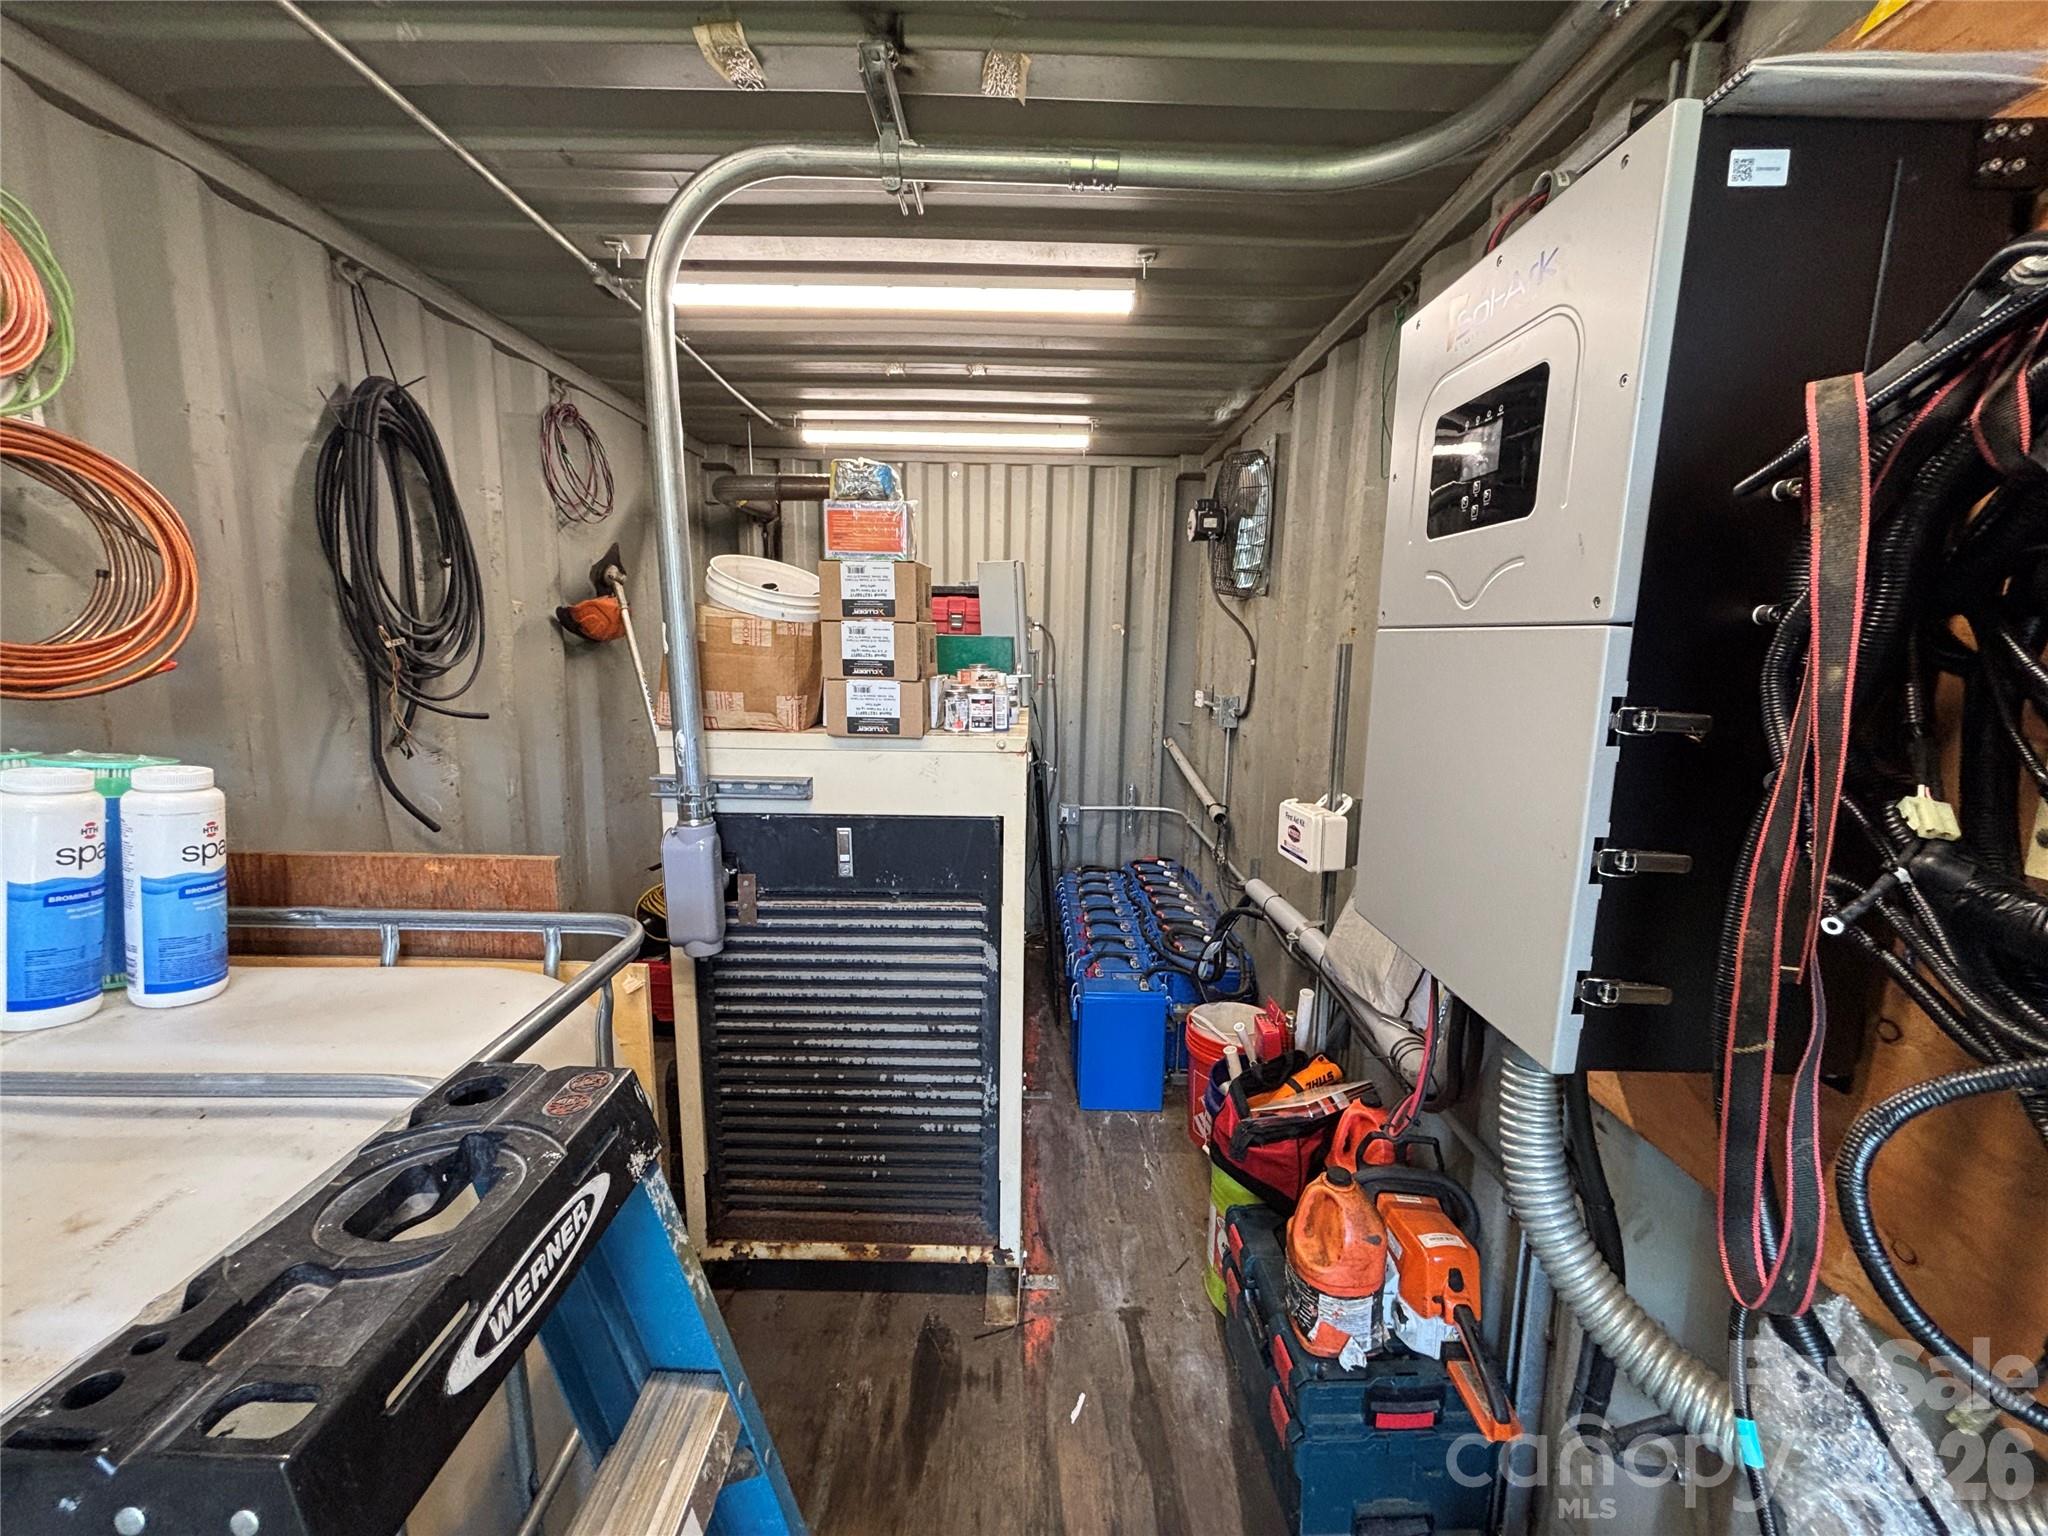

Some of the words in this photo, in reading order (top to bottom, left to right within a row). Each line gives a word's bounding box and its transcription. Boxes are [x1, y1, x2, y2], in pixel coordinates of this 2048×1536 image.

[81, 826, 98, 836] HTH
[203, 825, 219, 834] HTH
[185, 884, 219, 895] BROMINE
[48, 892, 90, 903] BROMINE
[1305, 1071, 1335, 1089] STIHL
[488, 1199, 589, 1342] WERNER
